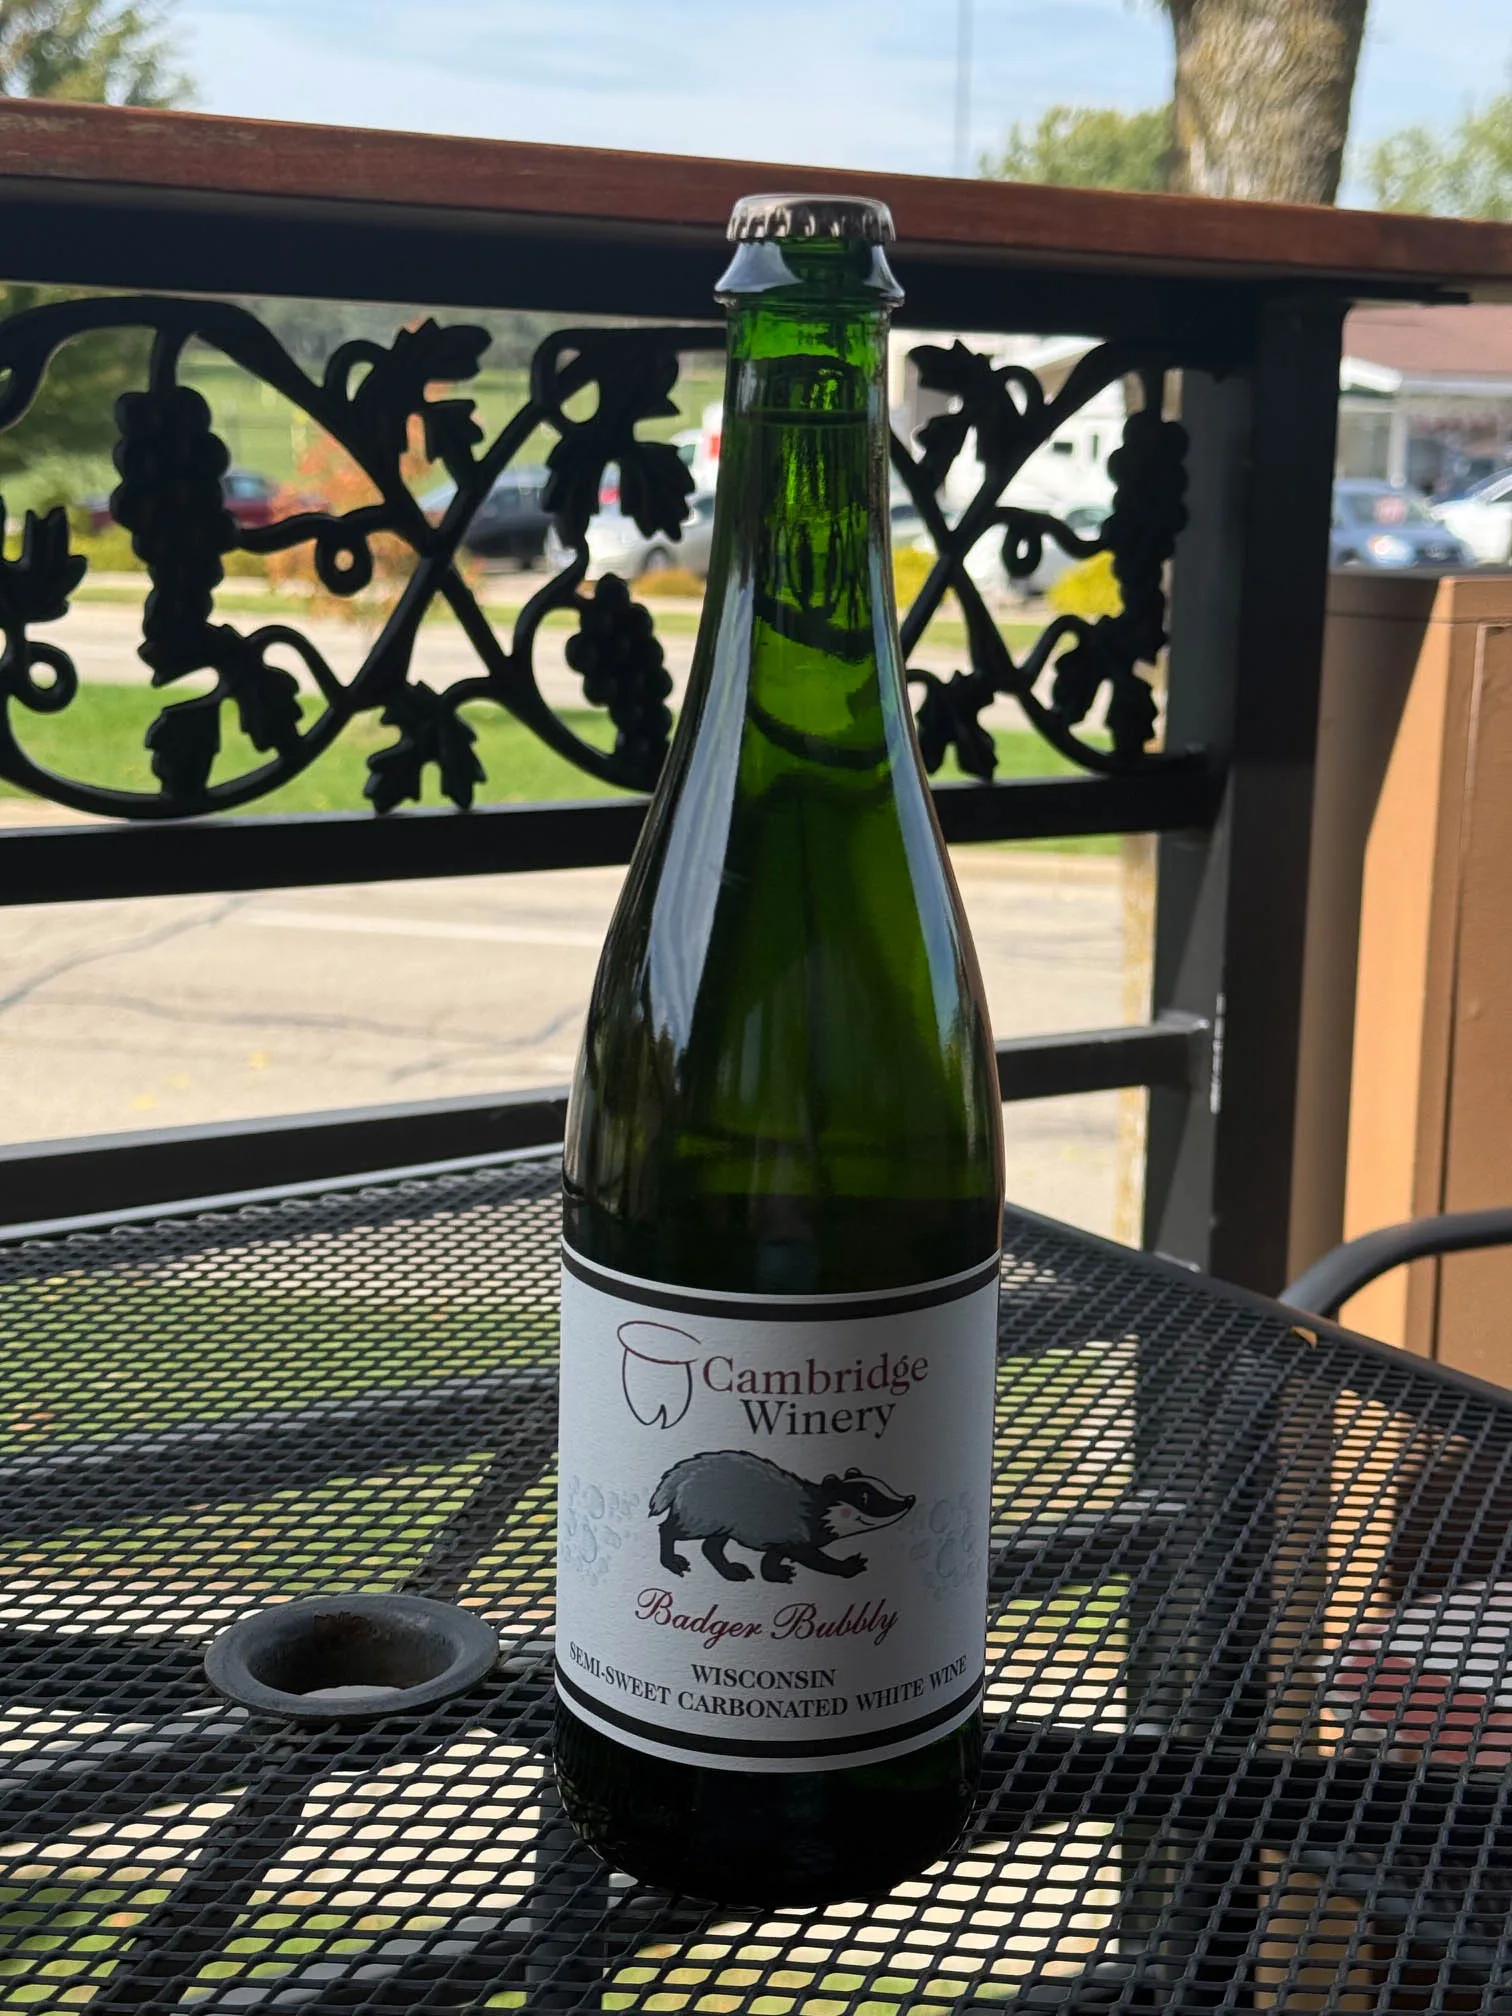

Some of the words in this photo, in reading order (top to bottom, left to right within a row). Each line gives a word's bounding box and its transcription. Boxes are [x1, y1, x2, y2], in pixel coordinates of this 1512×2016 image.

[703, 1352, 928, 1397] Cambridge
[740, 1399, 896, 1439] Winery
[634, 1587, 762, 1650] Badger
[770, 1598, 899, 1647] Bubbly
[569, 1641, 671, 1706] SEMI-SWEET
[678, 1690, 848, 1719] CARBONATED
[855, 1677, 924, 1713] WHITE
[928, 1655, 967, 1689] WINE
[690, 1663, 836, 1690] WISCONSIN
